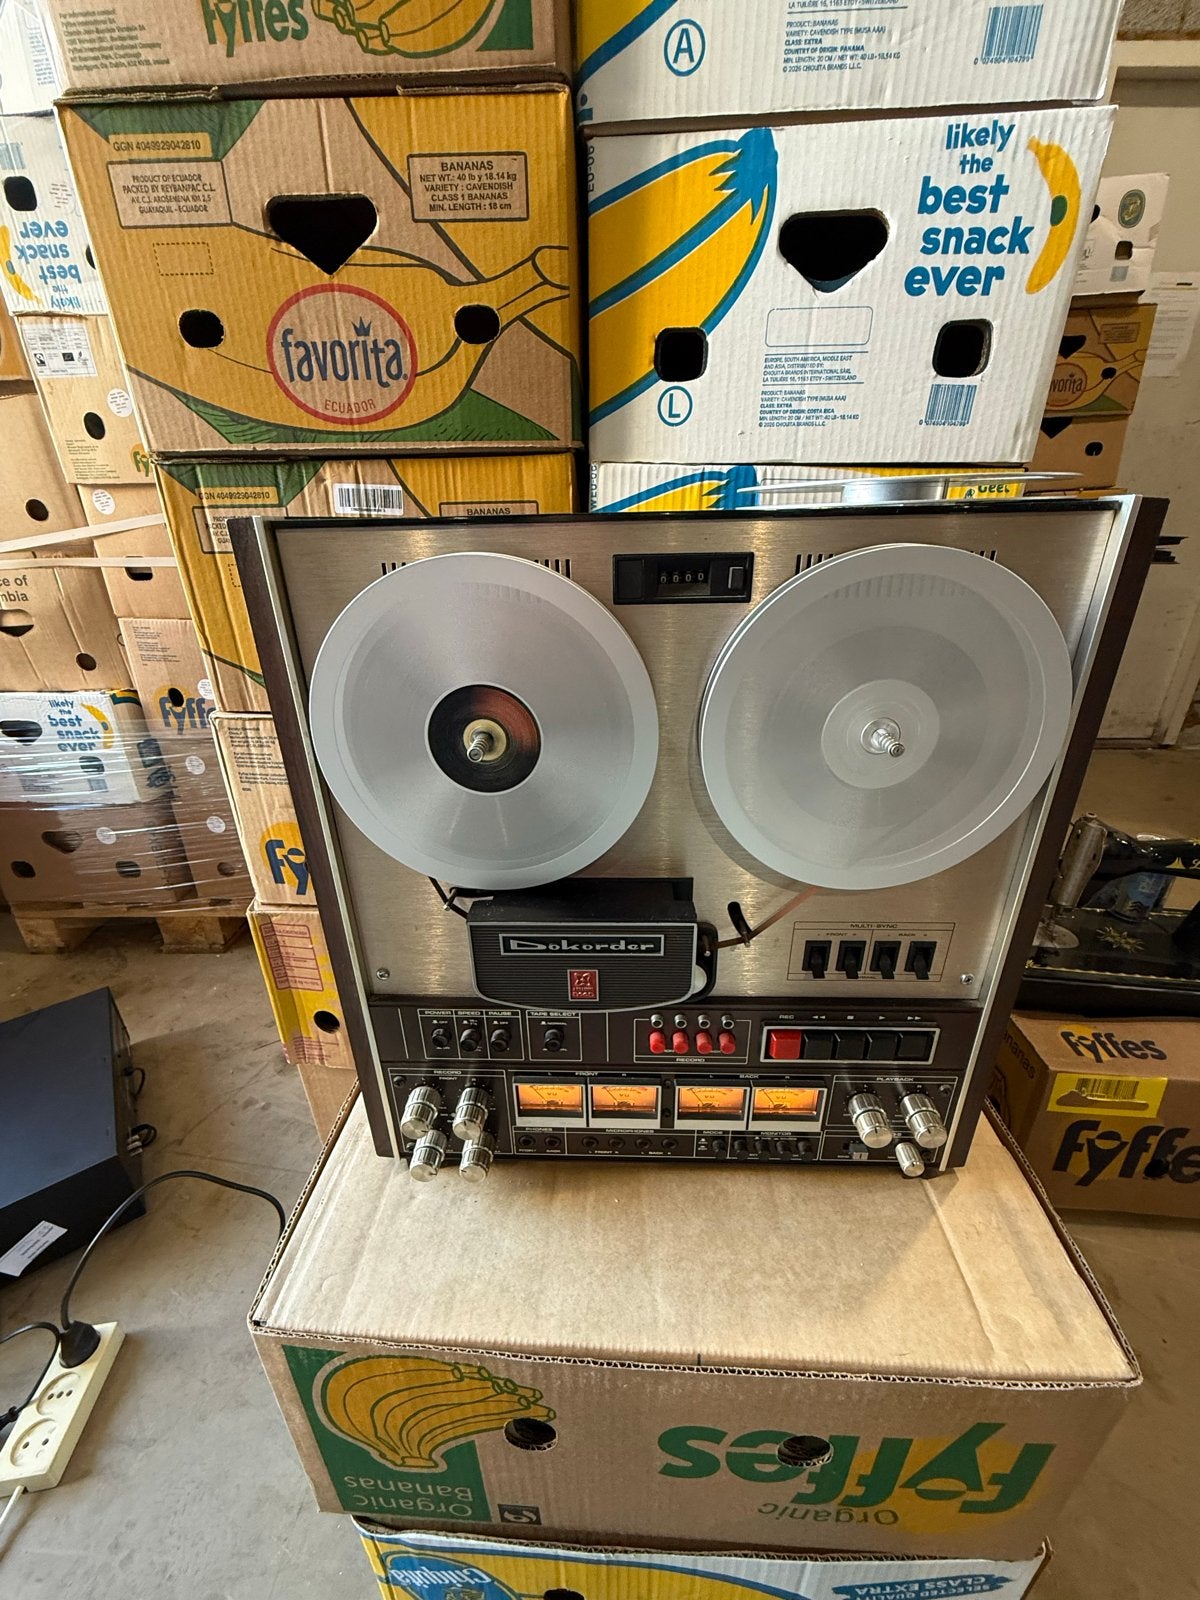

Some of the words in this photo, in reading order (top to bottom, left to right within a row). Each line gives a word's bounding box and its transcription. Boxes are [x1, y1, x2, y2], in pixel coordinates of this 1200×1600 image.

[673, 28, 695, 64] A
[945, 119, 1016, 152] likely
[113, 141, 134, 152] GGN
[441, 160, 494, 172] BANANAS
[959, 154, 994, 175] the
[132, 174, 160, 183] PRODUCT
[172, 173, 202, 182] ECUADOR
[420, 174, 436, 182] NET
[457, 173, 466, 181] 40
[468, 172, 476, 181] lb
[484, 172, 506, 180] 18.14
[507, 172, 517, 182] kg
[122, 184, 150, 194] PACKED
[151, 184, 159, 193] BY
[424, 184, 460, 192] VARIETY
[466, 182, 514, 191] CAVENDISH
[431, 194, 459, 202] CLASS
[468, 192, 508, 201] BANANAS
[917, 174, 1010, 215] best
[179, 204, 208, 213] ECUADOR
[429, 203, 446, 212] MIN.
[448, 202, 482, 211] LENGTH
[488, 202, 498, 210] 18
[499, 202, 512, 210] cm
[20, 220, 69, 239] ever
[920, 216, 1035, 255] snack
[14, 244, 70, 265] snack
[39, 265, 82, 285] best
[904, 266, 1006, 297] ever
[281, 327, 404, 388] favorita
[324, 398, 377, 414] ECUADOR
[669, 393, 681, 419] L
[467, 507, 511, 516] BANANAS
[14, 574, 28, 587] of
[49, 698, 74, 709] likely
[47, 714, 82, 727] best
[57, 728, 102, 740] snack
[58, 742, 97, 752] ever
[509, 939, 655, 950] Dokorder
[344, 1475, 472, 1501] Bananas
[352, 1494, 472, 1518] Organic
[757, 1502, 900, 1526] Organic
[855, 1583, 920, 1596] EXTRA
[925, 1577, 987, 1589] CLASS
[920, 1584, 990, 1597] SELECTED
